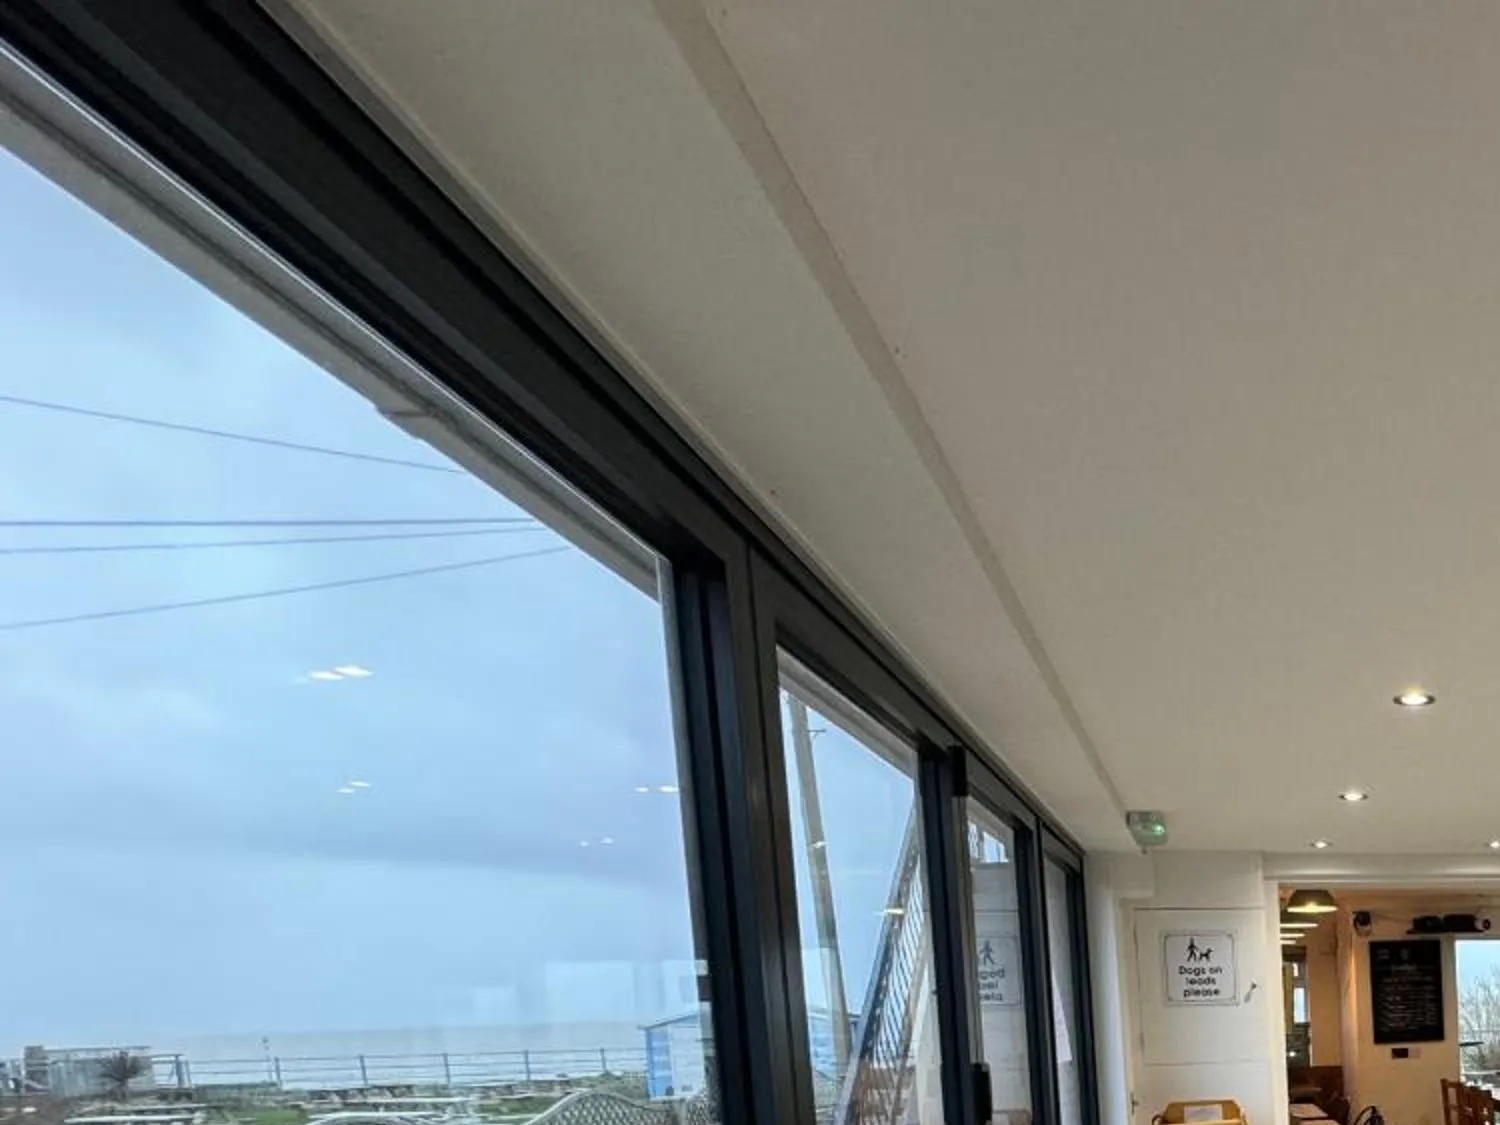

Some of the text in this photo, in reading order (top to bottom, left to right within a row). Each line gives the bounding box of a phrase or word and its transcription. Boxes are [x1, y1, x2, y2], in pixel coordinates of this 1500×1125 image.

[1178, 965, 1223, 976] Dogs on
[1185, 976, 1217, 986] leads
[1184, 987, 1220, 998] please
